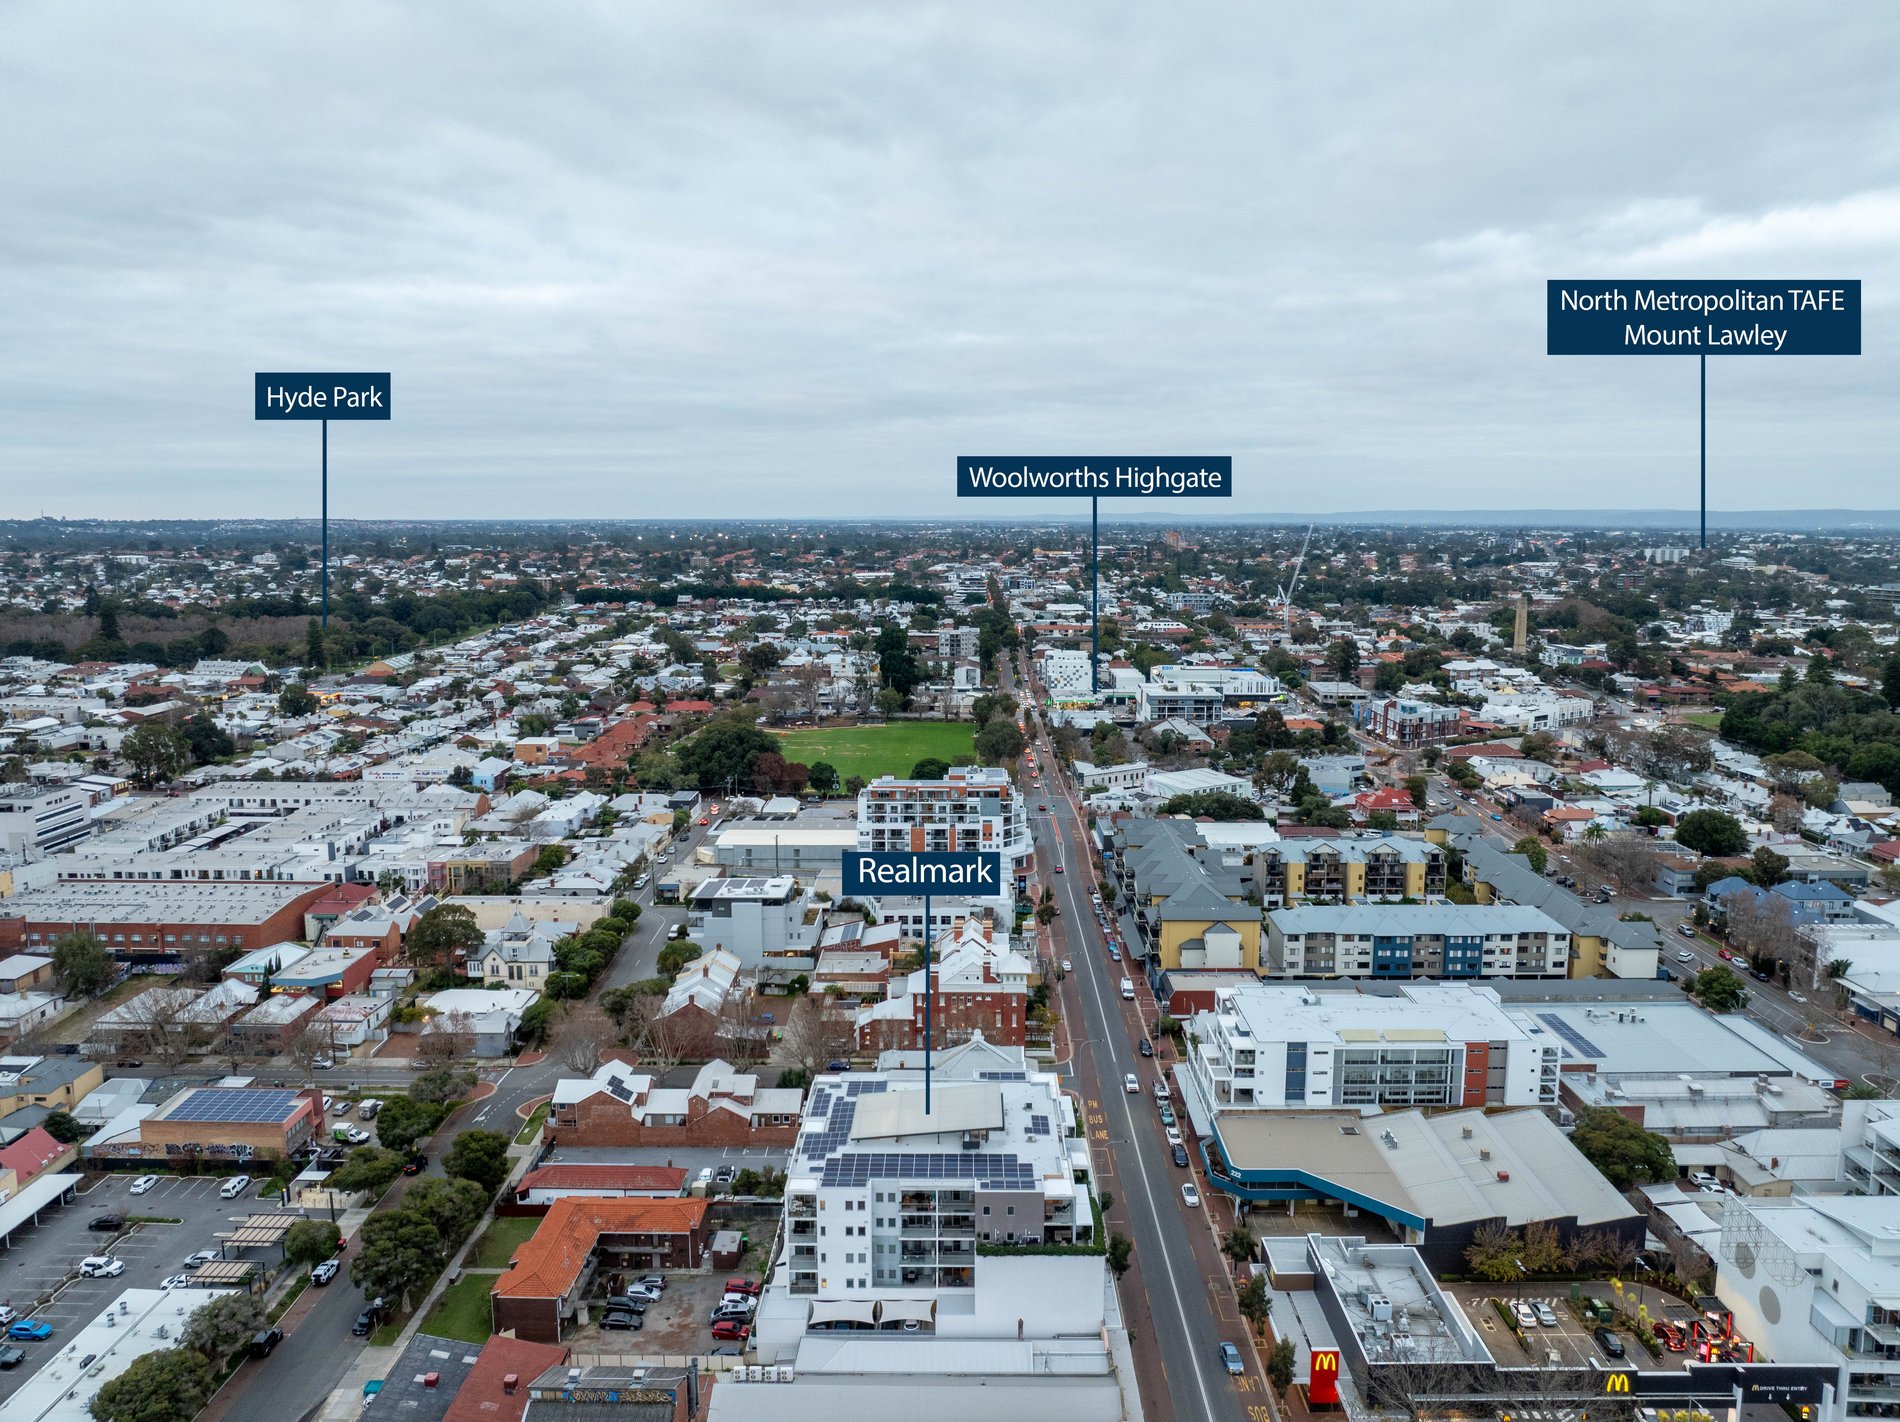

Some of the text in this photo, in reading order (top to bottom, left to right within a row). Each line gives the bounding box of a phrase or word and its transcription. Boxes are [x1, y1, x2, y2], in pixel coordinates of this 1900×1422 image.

[1087, 1099, 1099, 1109] PM
[1088, 1114, 1104, 1124] BUS
[1090, 1129, 1109, 1140] LANE
[1236, 1375, 1263, 1393] LANE
[1247, 1405, 1271, 1422] BUS
